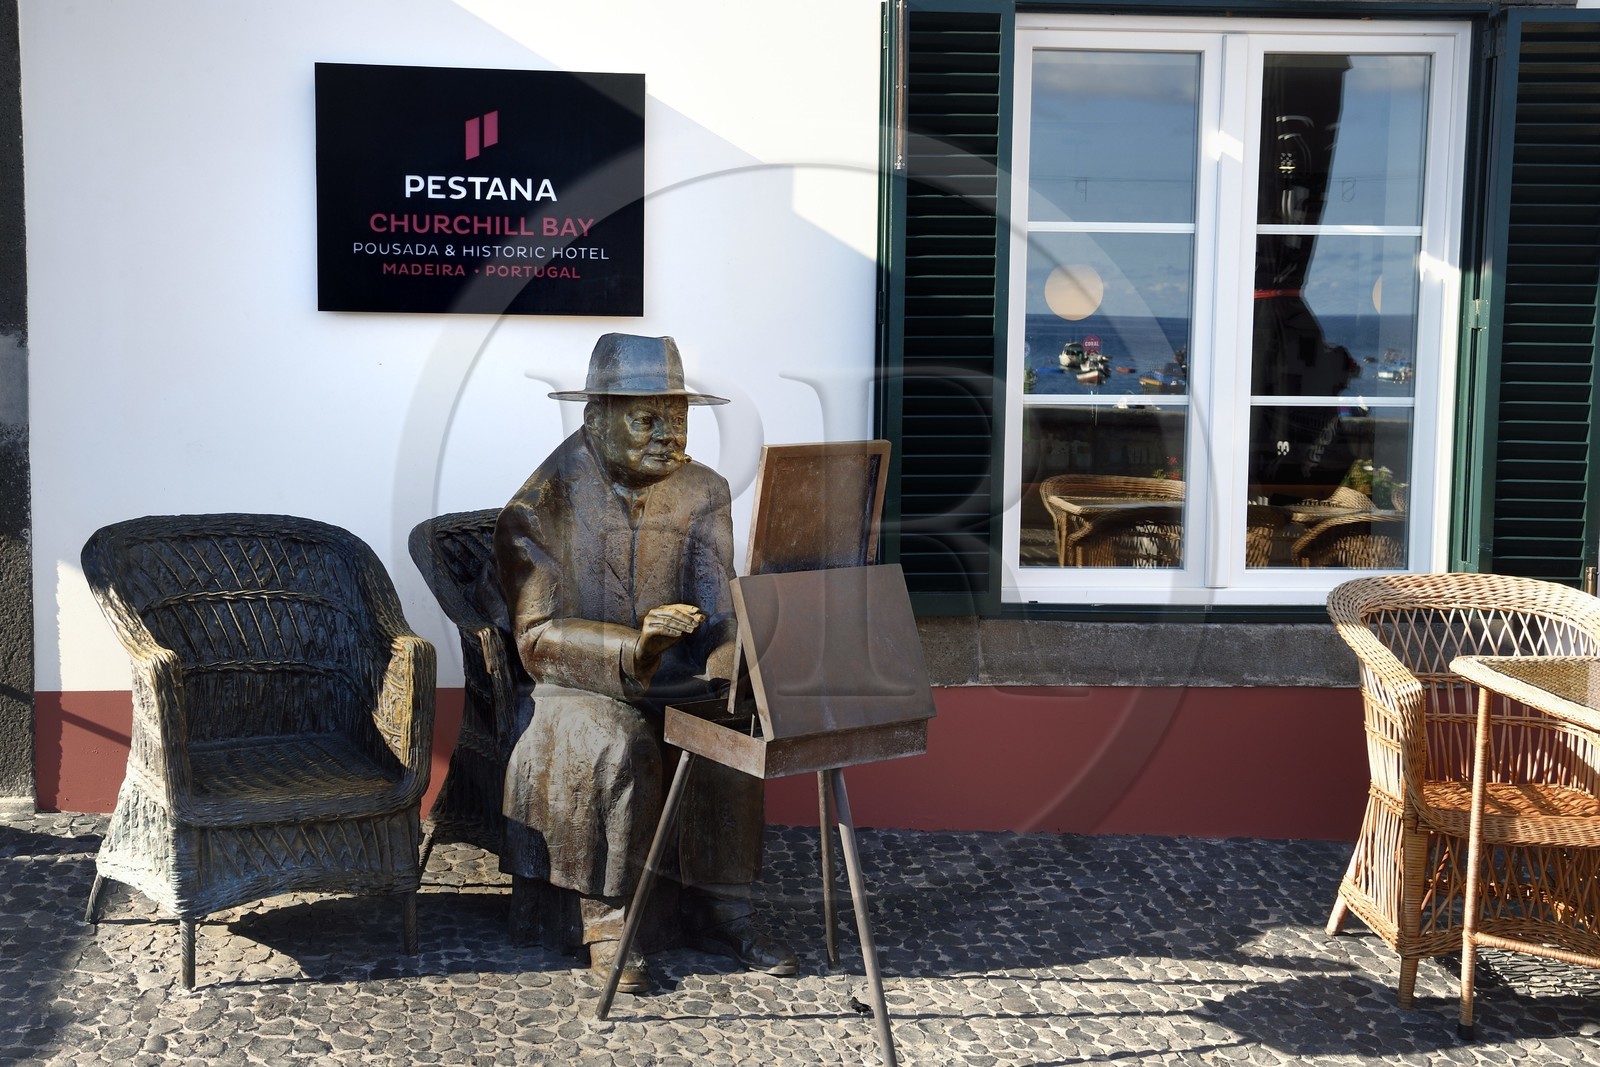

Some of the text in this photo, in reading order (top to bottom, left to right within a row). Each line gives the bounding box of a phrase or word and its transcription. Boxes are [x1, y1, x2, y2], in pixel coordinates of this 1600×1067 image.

[405, 175, 557, 202] PESTANA
[370, 213, 594, 237] CHURCHILL BAY
[353, 242, 609, 260] POUSADA & HISTORIC HOTEL
[383, 263, 581, 279] MADEIRA PORTUGAL
